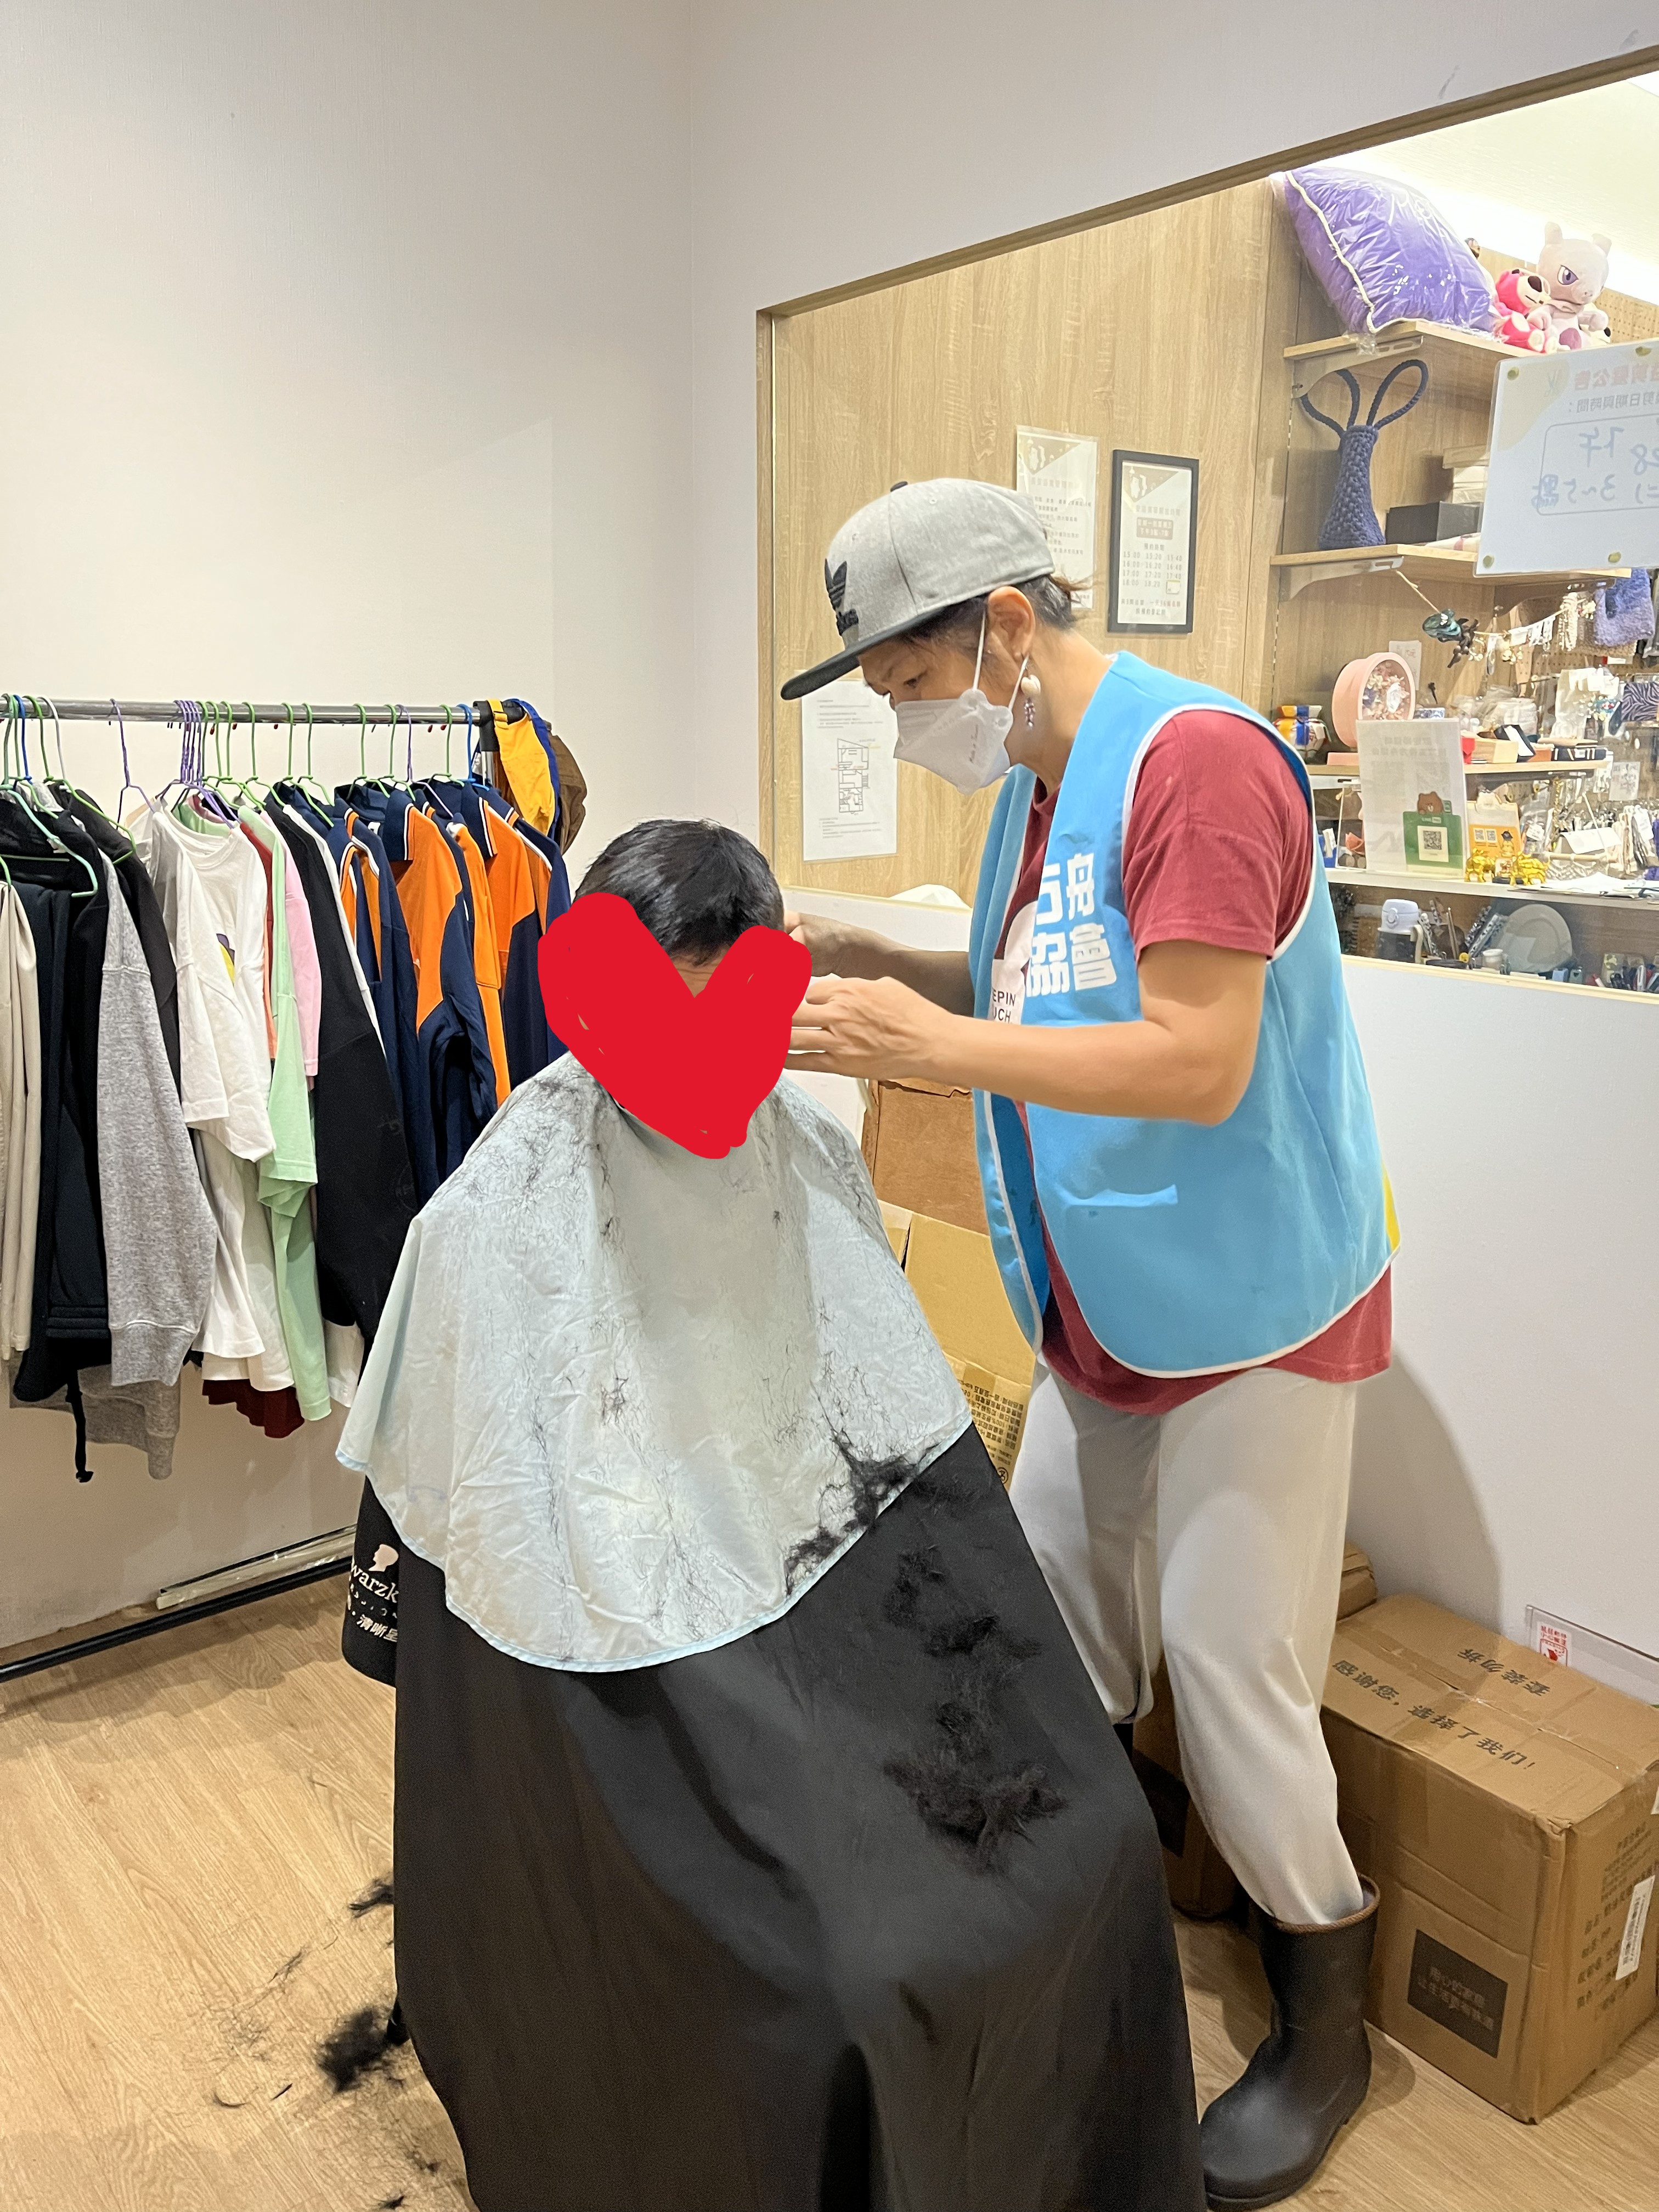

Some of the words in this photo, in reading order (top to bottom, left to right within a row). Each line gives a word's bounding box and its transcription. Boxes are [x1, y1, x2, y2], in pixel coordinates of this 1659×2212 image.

[351, 1555, 399, 1603] warzk
[1457, 1649, 1550, 1696] 套装勿拆
